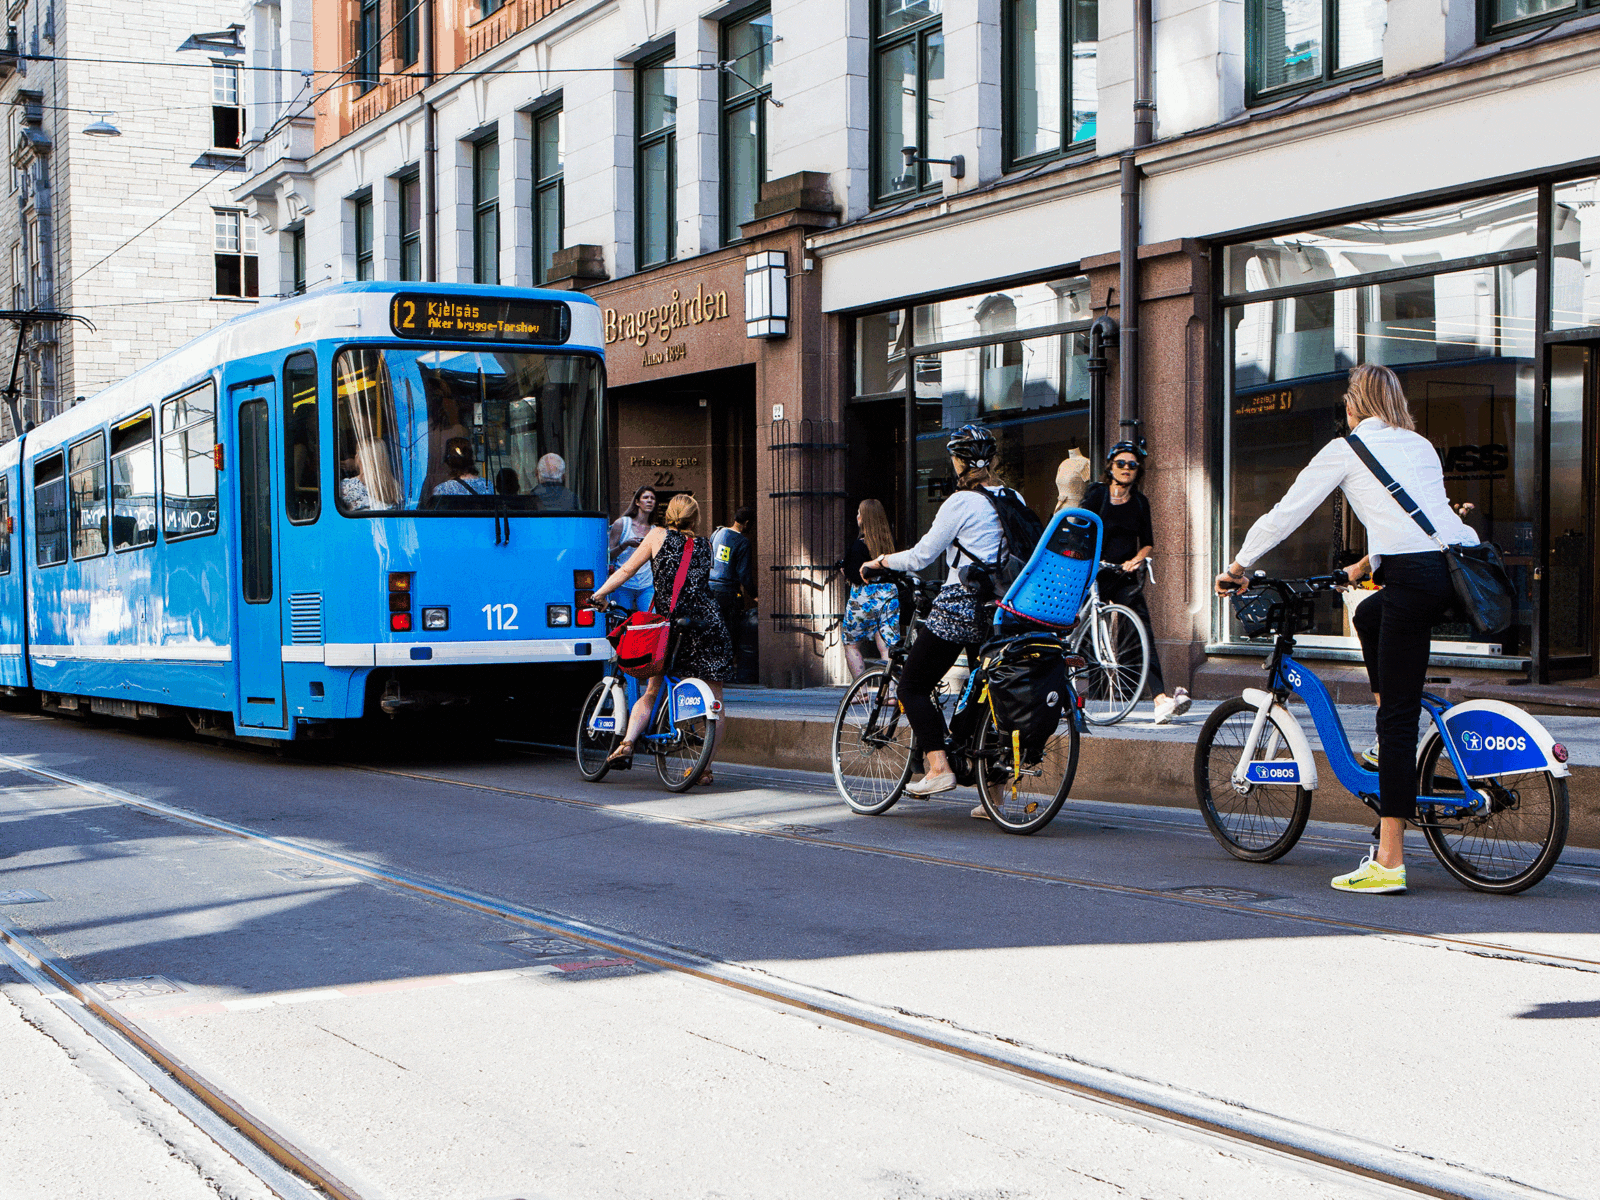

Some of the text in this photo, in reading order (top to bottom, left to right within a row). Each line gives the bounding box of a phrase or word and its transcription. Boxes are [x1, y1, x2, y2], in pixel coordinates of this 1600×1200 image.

[428, 302, 480, 318] Kjelsås
[604, 283, 729, 347] Bragegården
[428, 317, 454, 329] Aker
[642, 342, 686, 367] Anno 1894
[630, 455, 698, 468] Prinsens gate
[654, 471, 674, 487] 22
[481, 603, 519, 630] 112
[685, 696, 701, 706] OBOS
[1484, 736, 1527, 751] OBOS
[1270, 768, 1295, 778] OBOS
